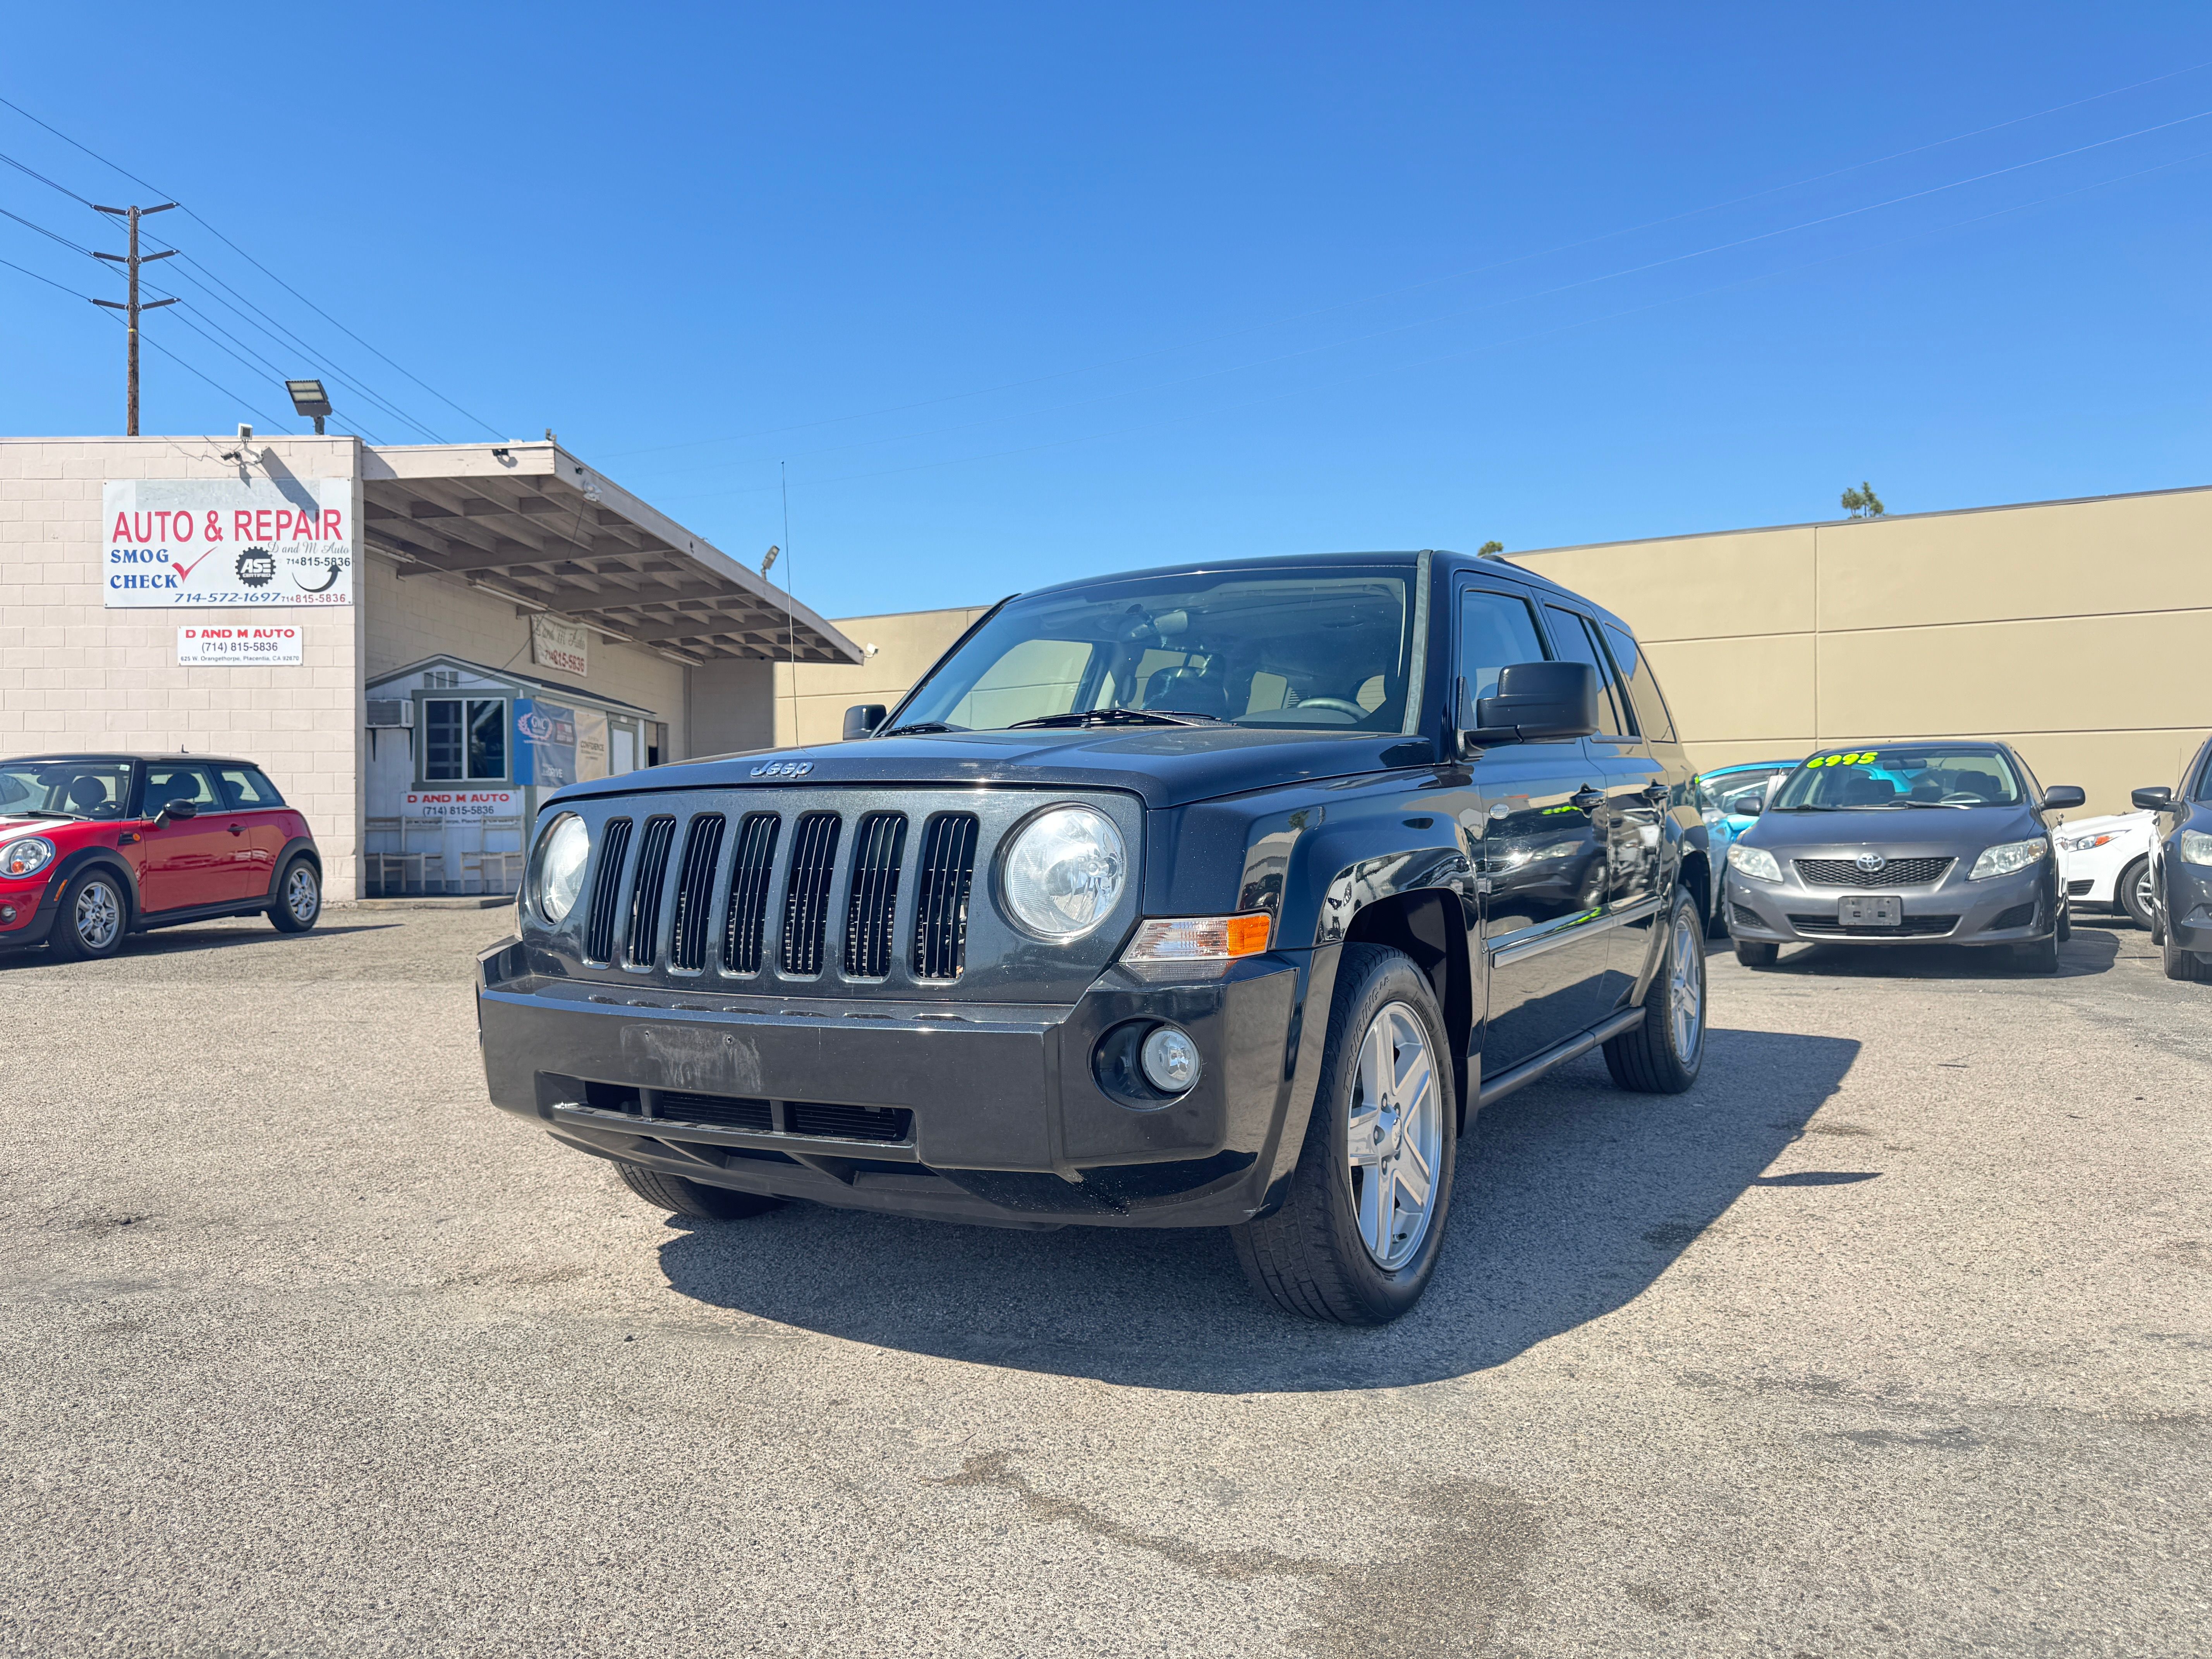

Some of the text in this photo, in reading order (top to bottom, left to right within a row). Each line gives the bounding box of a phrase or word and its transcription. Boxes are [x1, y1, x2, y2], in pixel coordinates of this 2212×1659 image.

[112, 509, 343, 543] AUTO & REPAIR
[268, 541, 349, 554] D and M Auto
[110, 549, 169, 563] SMOG
[240, 558, 271, 573] ASE
[110, 574, 178, 589] CHECK
[175, 592, 281, 602] 714-572-1697
[186, 629, 295, 638] D AND M AUTO
[202, 642, 278, 653] (714) 815-5836
[1806, 752, 1878, 769] 6995
[750, 760, 814, 779] Jeep
[422, 794, 452, 803] AND
[456, 794, 466, 803] M
[471, 793, 510, 802] AUTO
[423, 805, 494, 817] (714) 815-5836
